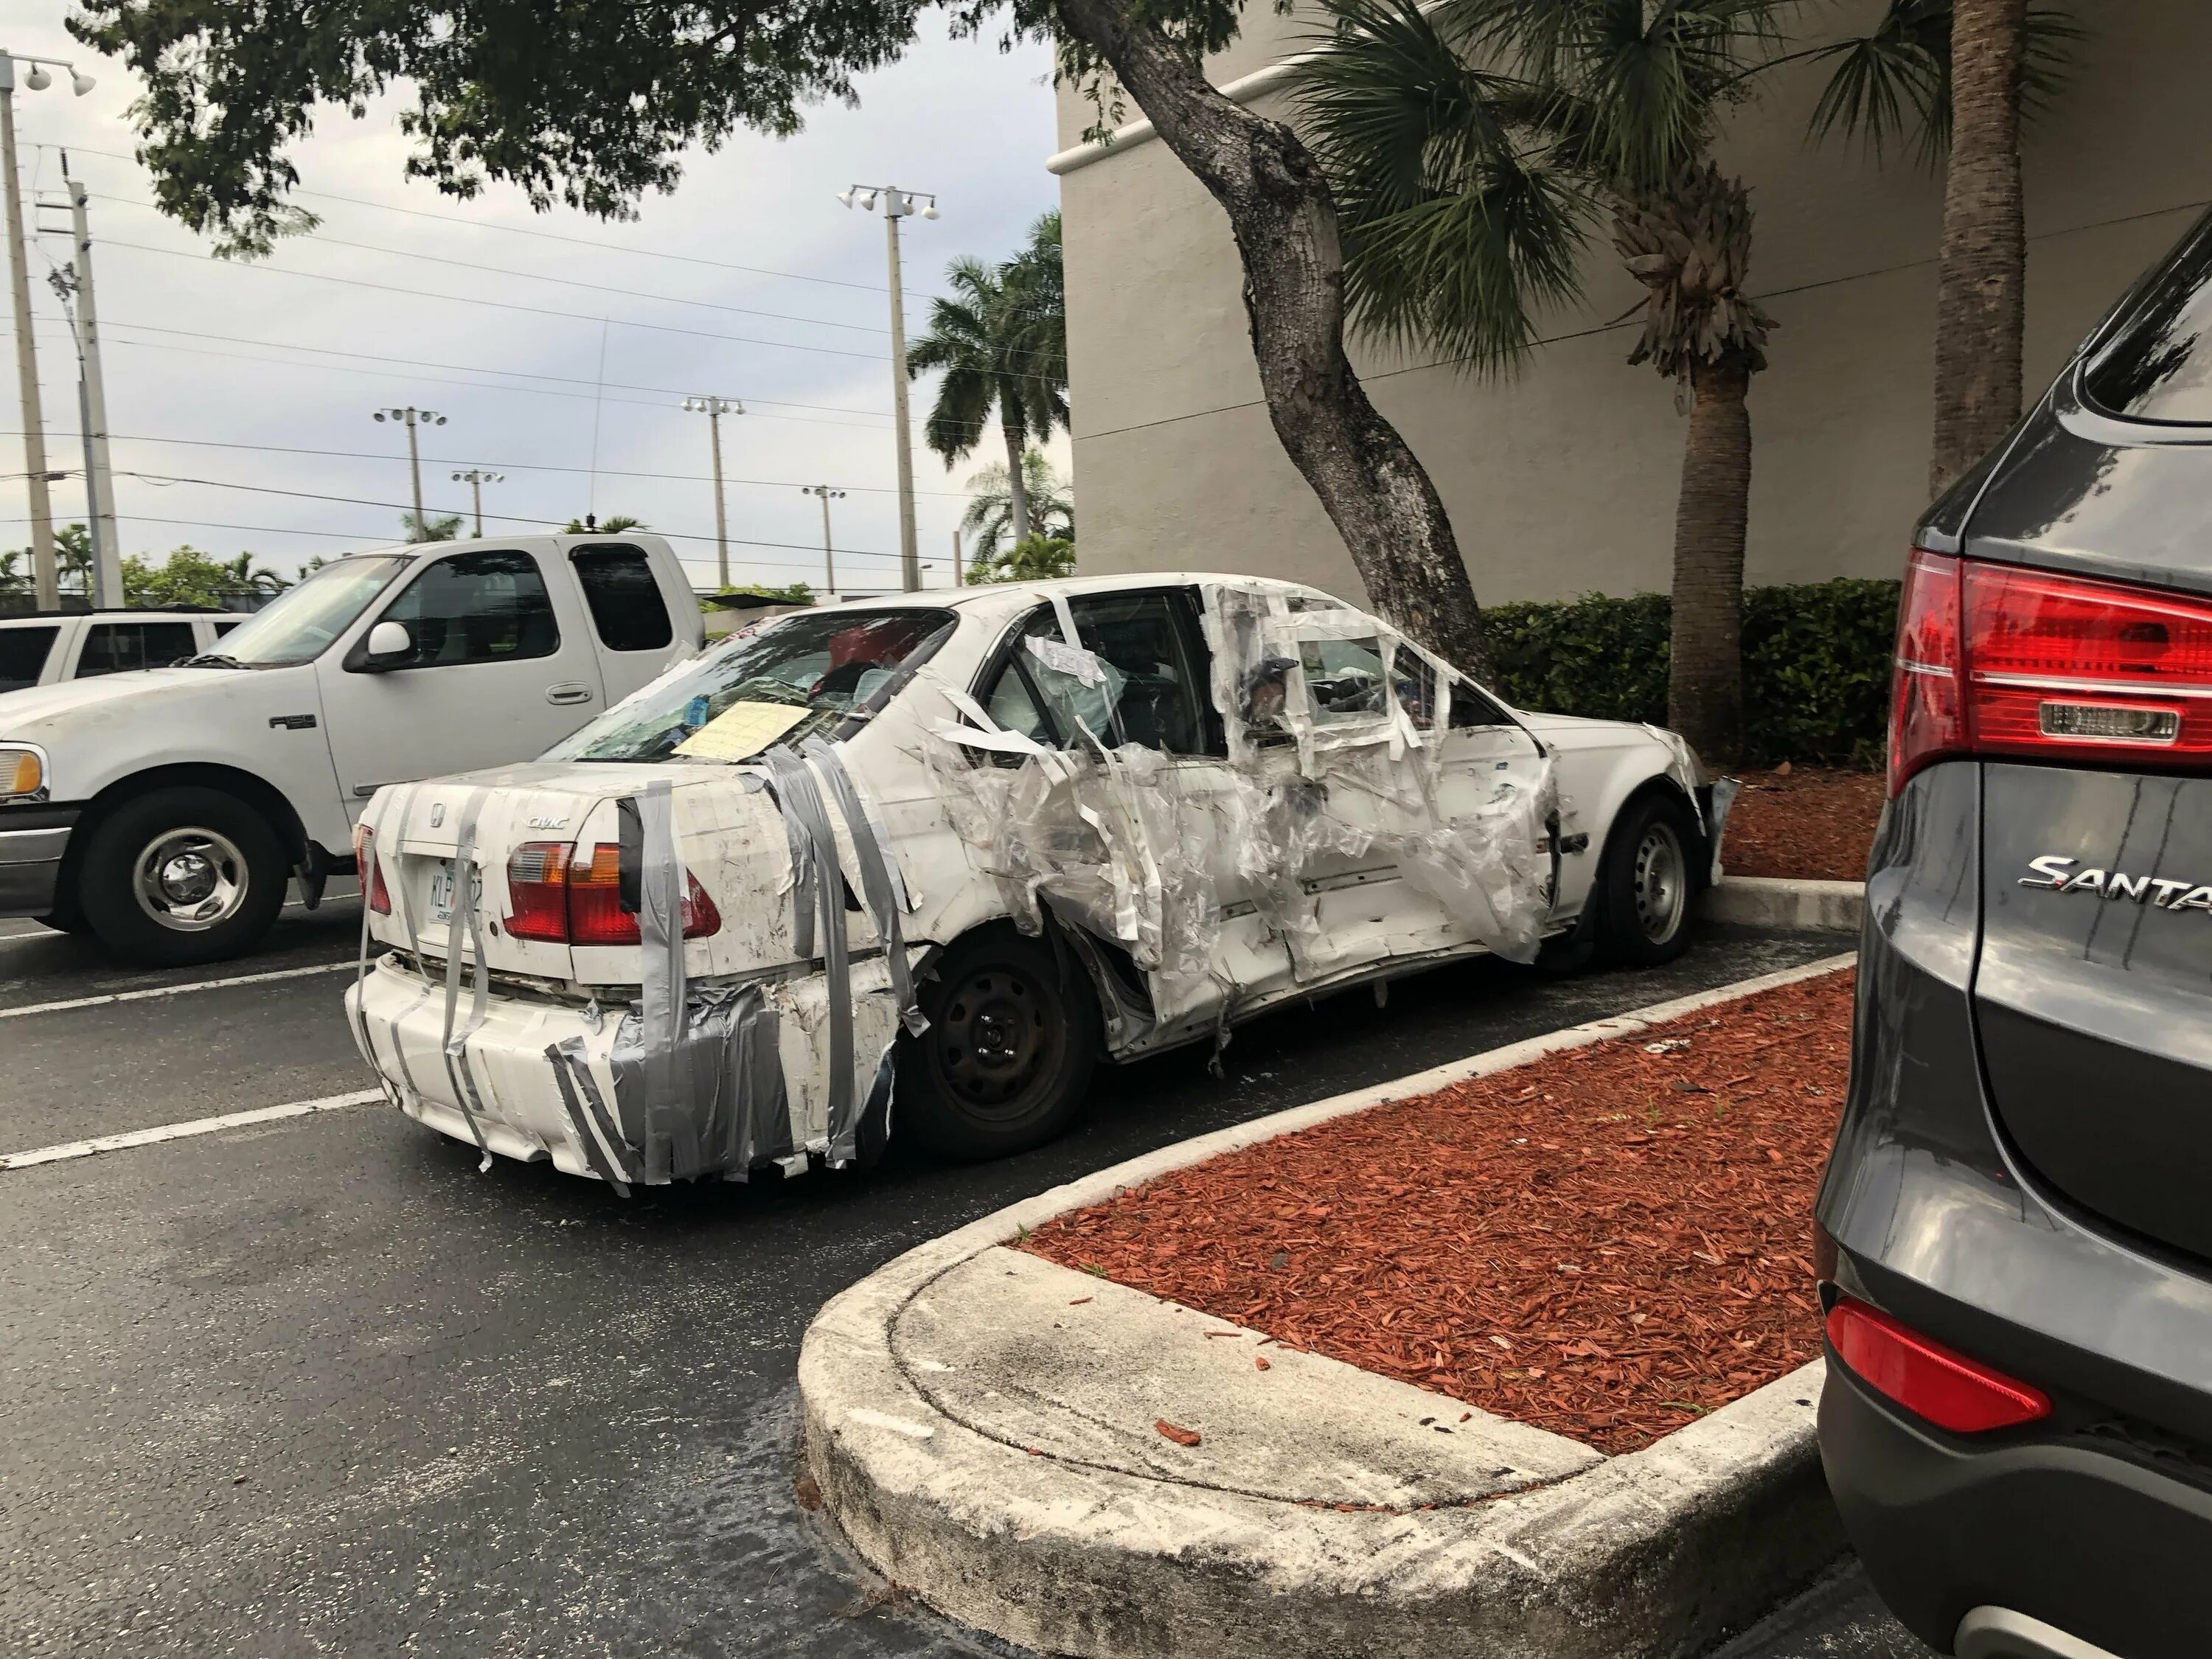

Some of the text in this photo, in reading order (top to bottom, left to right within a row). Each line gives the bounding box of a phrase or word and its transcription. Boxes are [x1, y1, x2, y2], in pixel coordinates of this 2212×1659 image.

[527, 815, 569, 830] CIVIC
[431, 874, 452, 908] KLP
[2017, 855, 2212, 915] SANTA
